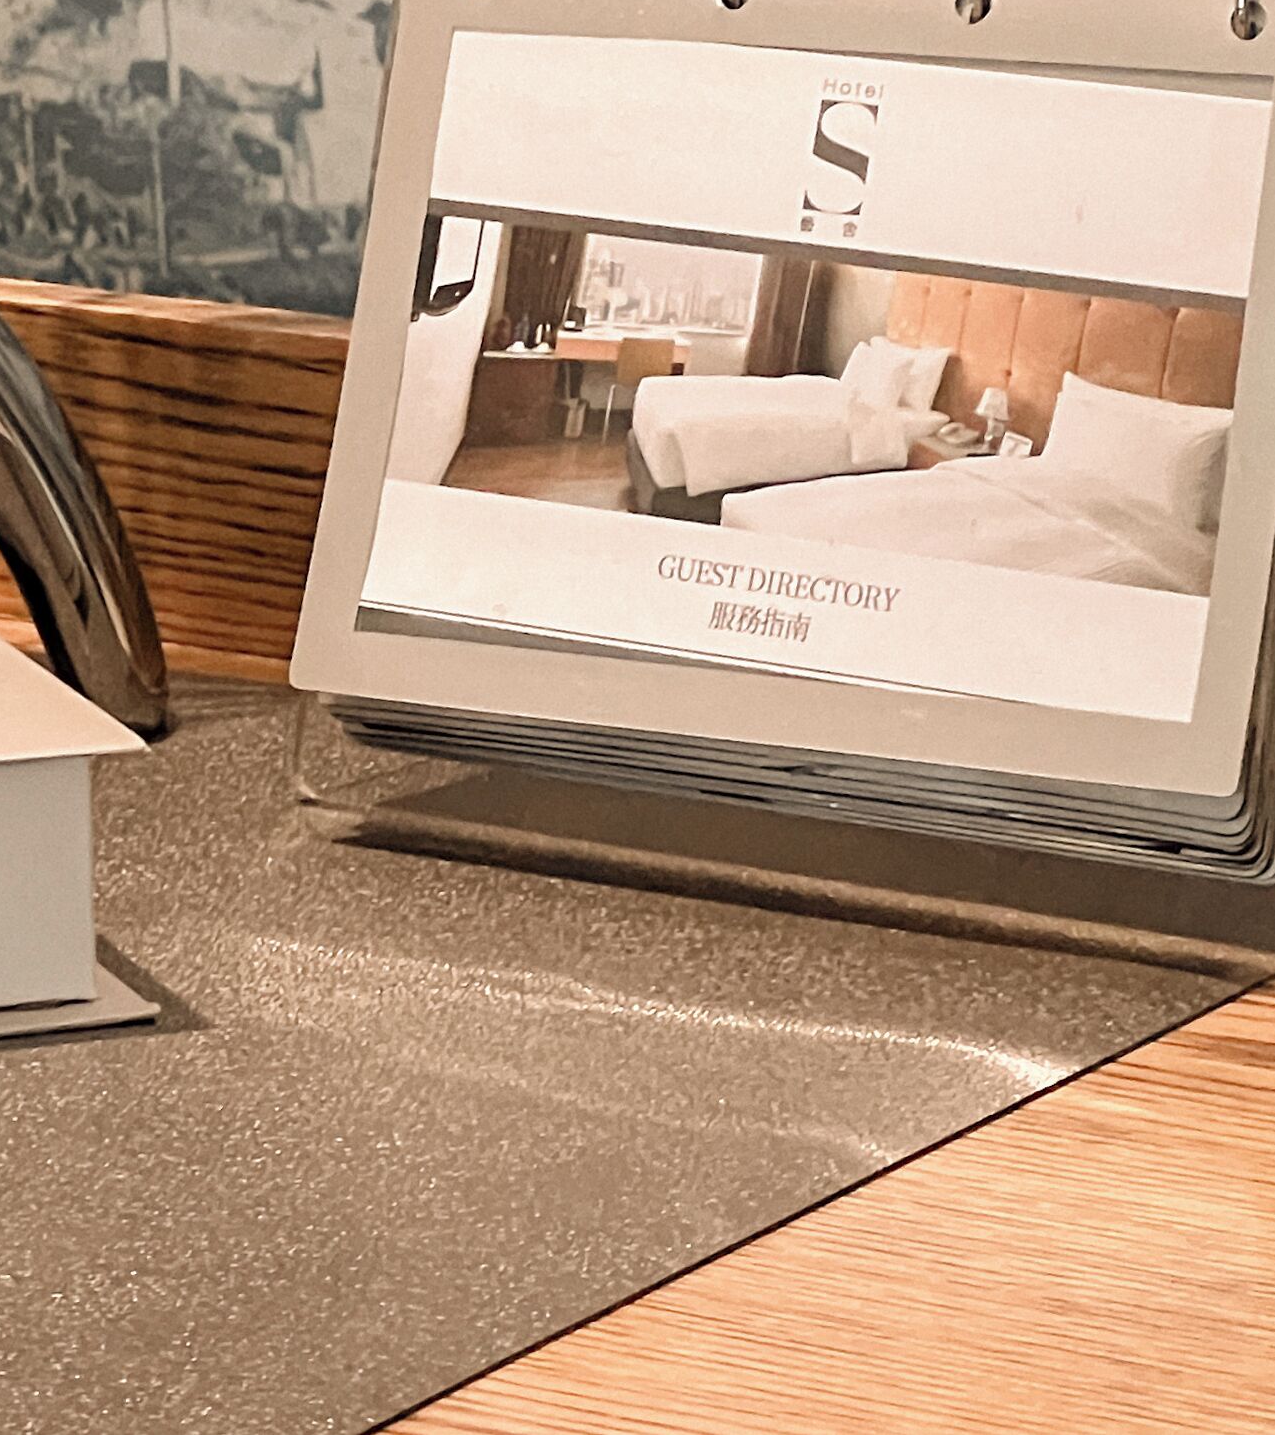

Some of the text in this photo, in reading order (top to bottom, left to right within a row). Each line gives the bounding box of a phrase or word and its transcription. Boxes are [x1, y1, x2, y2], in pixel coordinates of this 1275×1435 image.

[821, 76, 885, 100] Hotel
[801, 98, 880, 217] S
[657, 553, 902, 613] GUEST DIRECTORY
[707, 600, 813, 644] 服務指南
